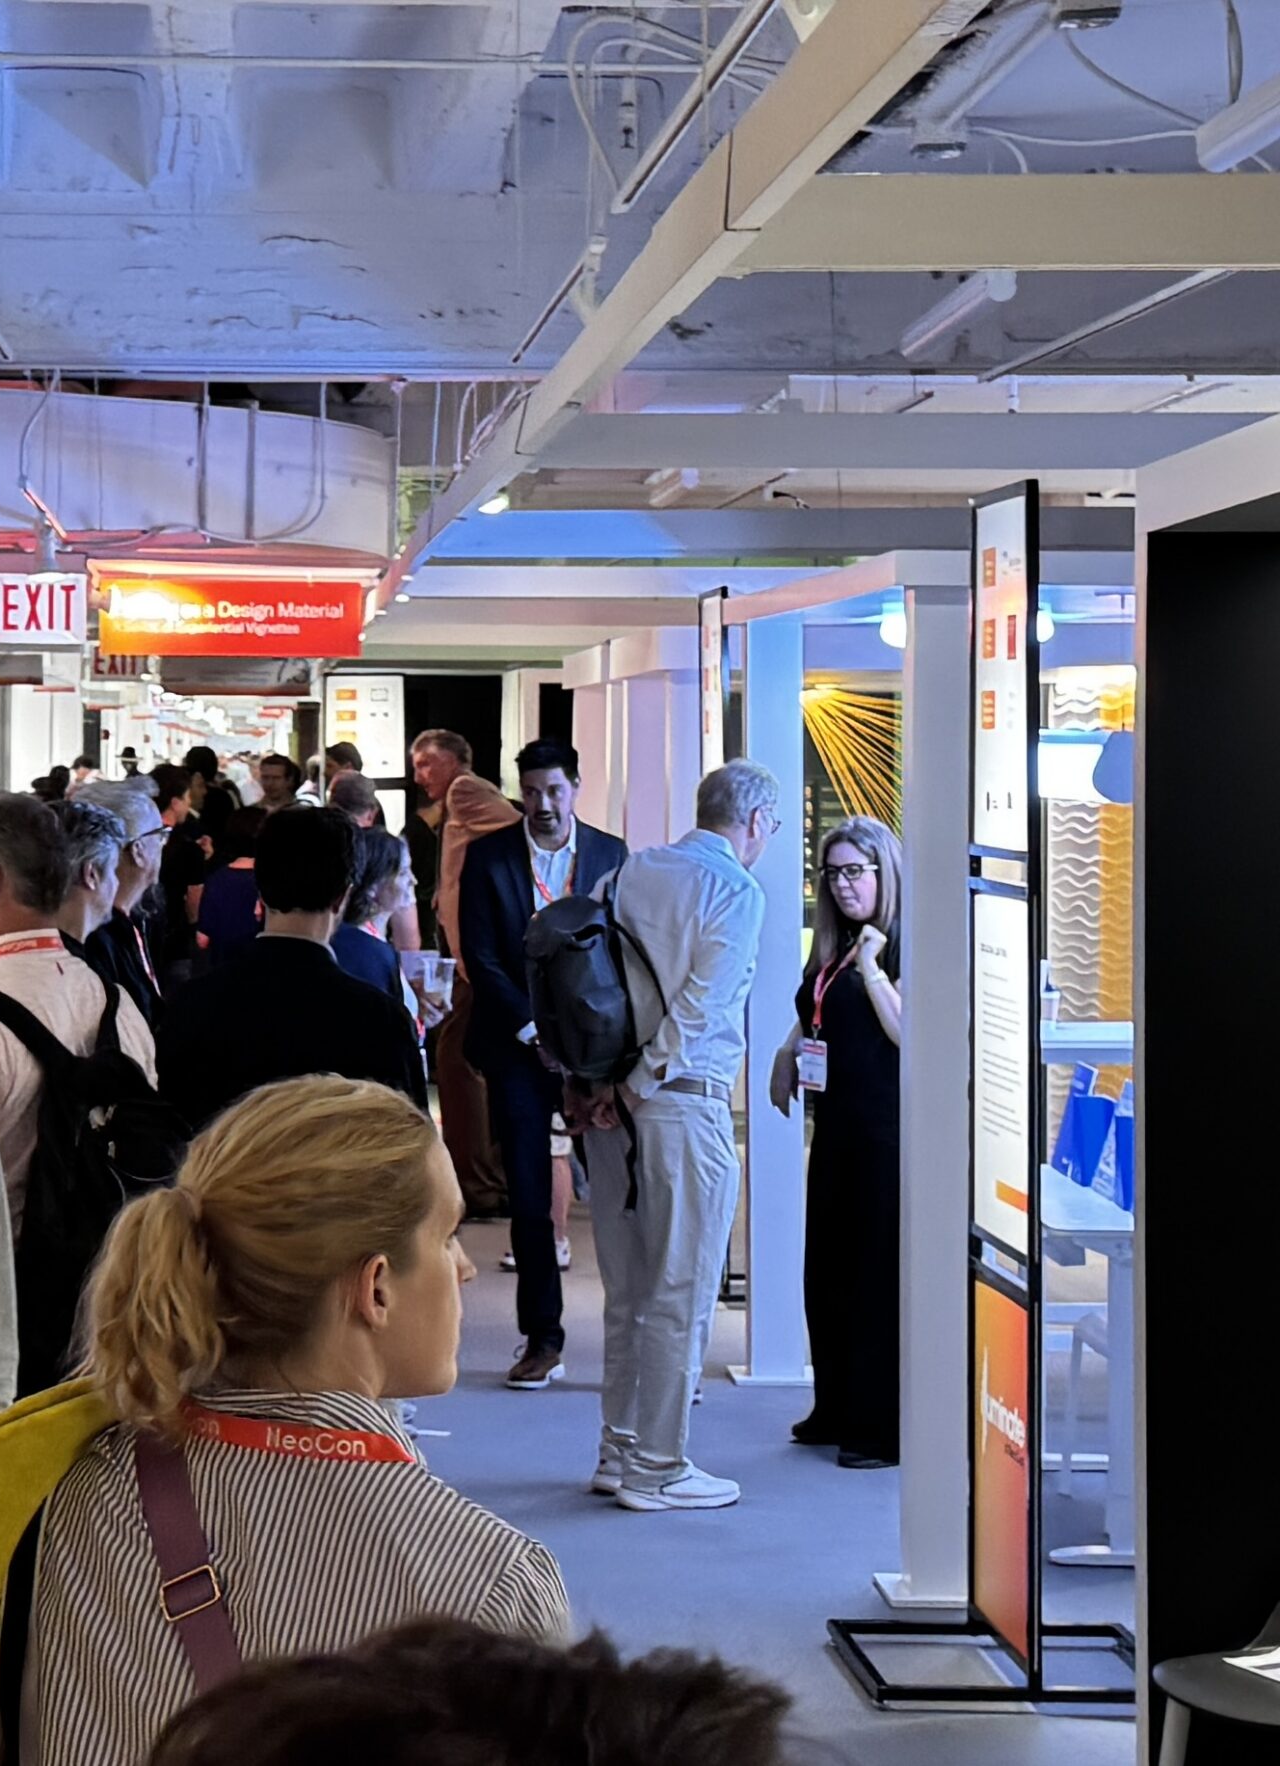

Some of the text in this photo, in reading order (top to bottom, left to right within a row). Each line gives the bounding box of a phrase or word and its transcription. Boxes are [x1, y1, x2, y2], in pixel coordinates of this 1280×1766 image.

[2, 584, 76, 631] EXIT
[218, 600, 275, 622] Design
[277, 601, 344, 619] Material
[265, 1426, 367, 1457] NeoCon
